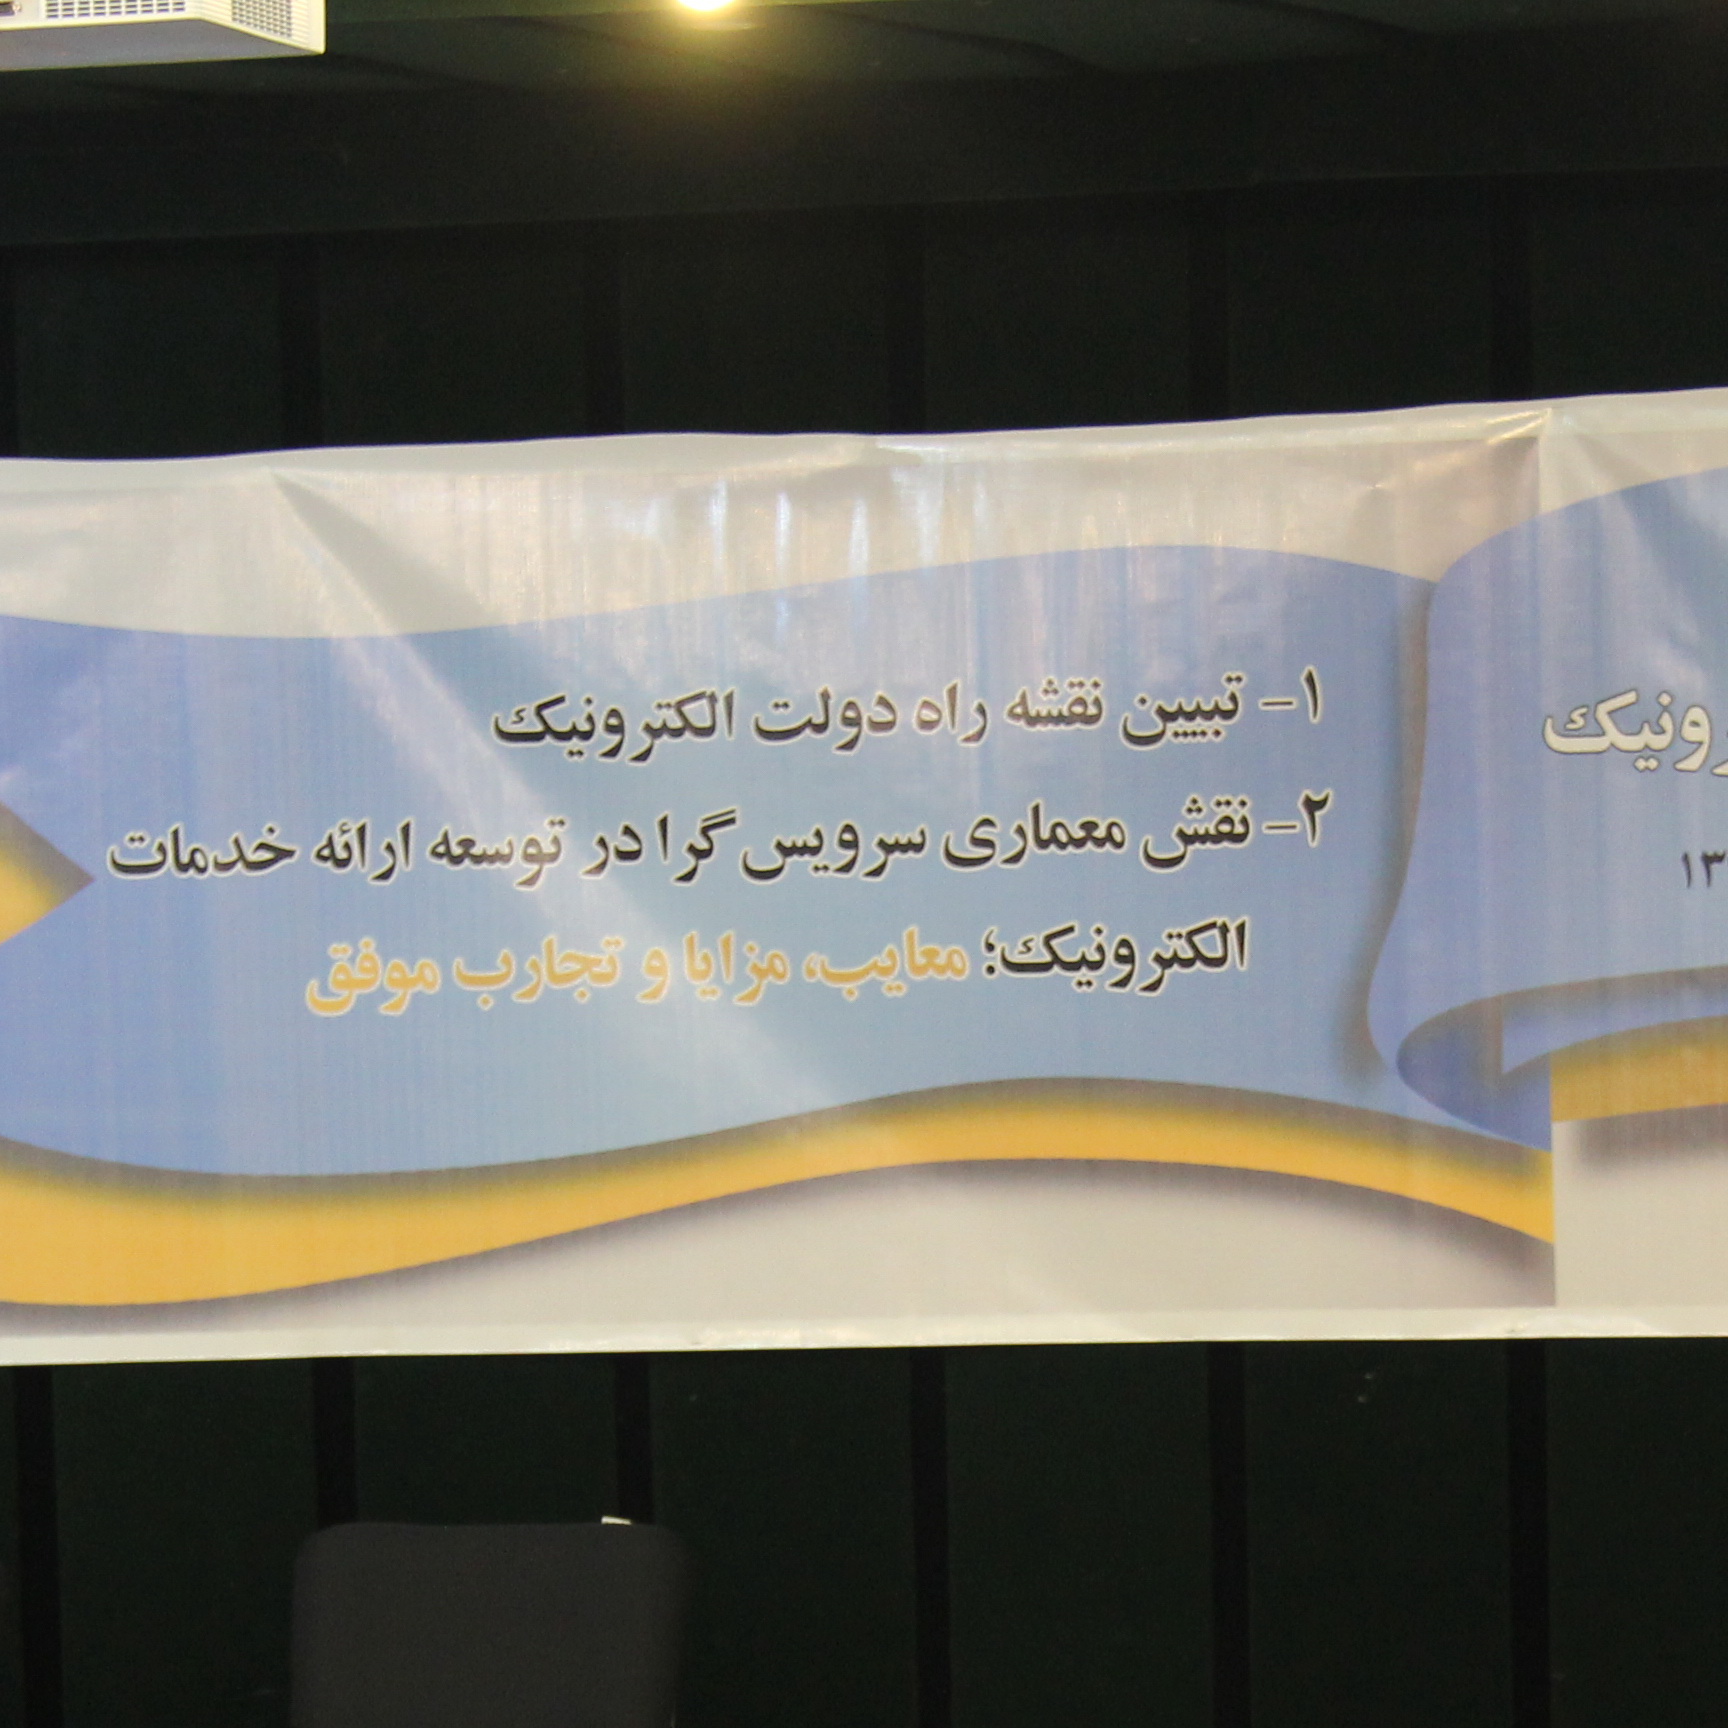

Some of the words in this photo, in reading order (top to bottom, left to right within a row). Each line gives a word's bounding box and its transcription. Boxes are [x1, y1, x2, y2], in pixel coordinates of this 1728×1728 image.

[493, 688, 735, 763] الکترونیک
[752, 681, 897, 753] دولت
[913, 680, 987, 745] راه
[1004, 677, 1104, 732] نقشه
[1120, 671, 1243, 749] تبیین
[108, 823, 297, 878] خدمات
[312, 817, 413, 884] ارائه
[428, 816, 566, 888] توسعه
[581, 821, 644, 878] در
[656, 806, 738, 884] گرا
[740, 822, 928, 882] سرویس
[942, 802, 1127, 872] معماری
[1140, 798, 1252, 872] نقش
[305, 936, 441, 1016] موفق
[454, 935, 623, 1010] تجارب
[637, 944, 669, 1002] و
[684, 931, 788, 1004] مزایا
